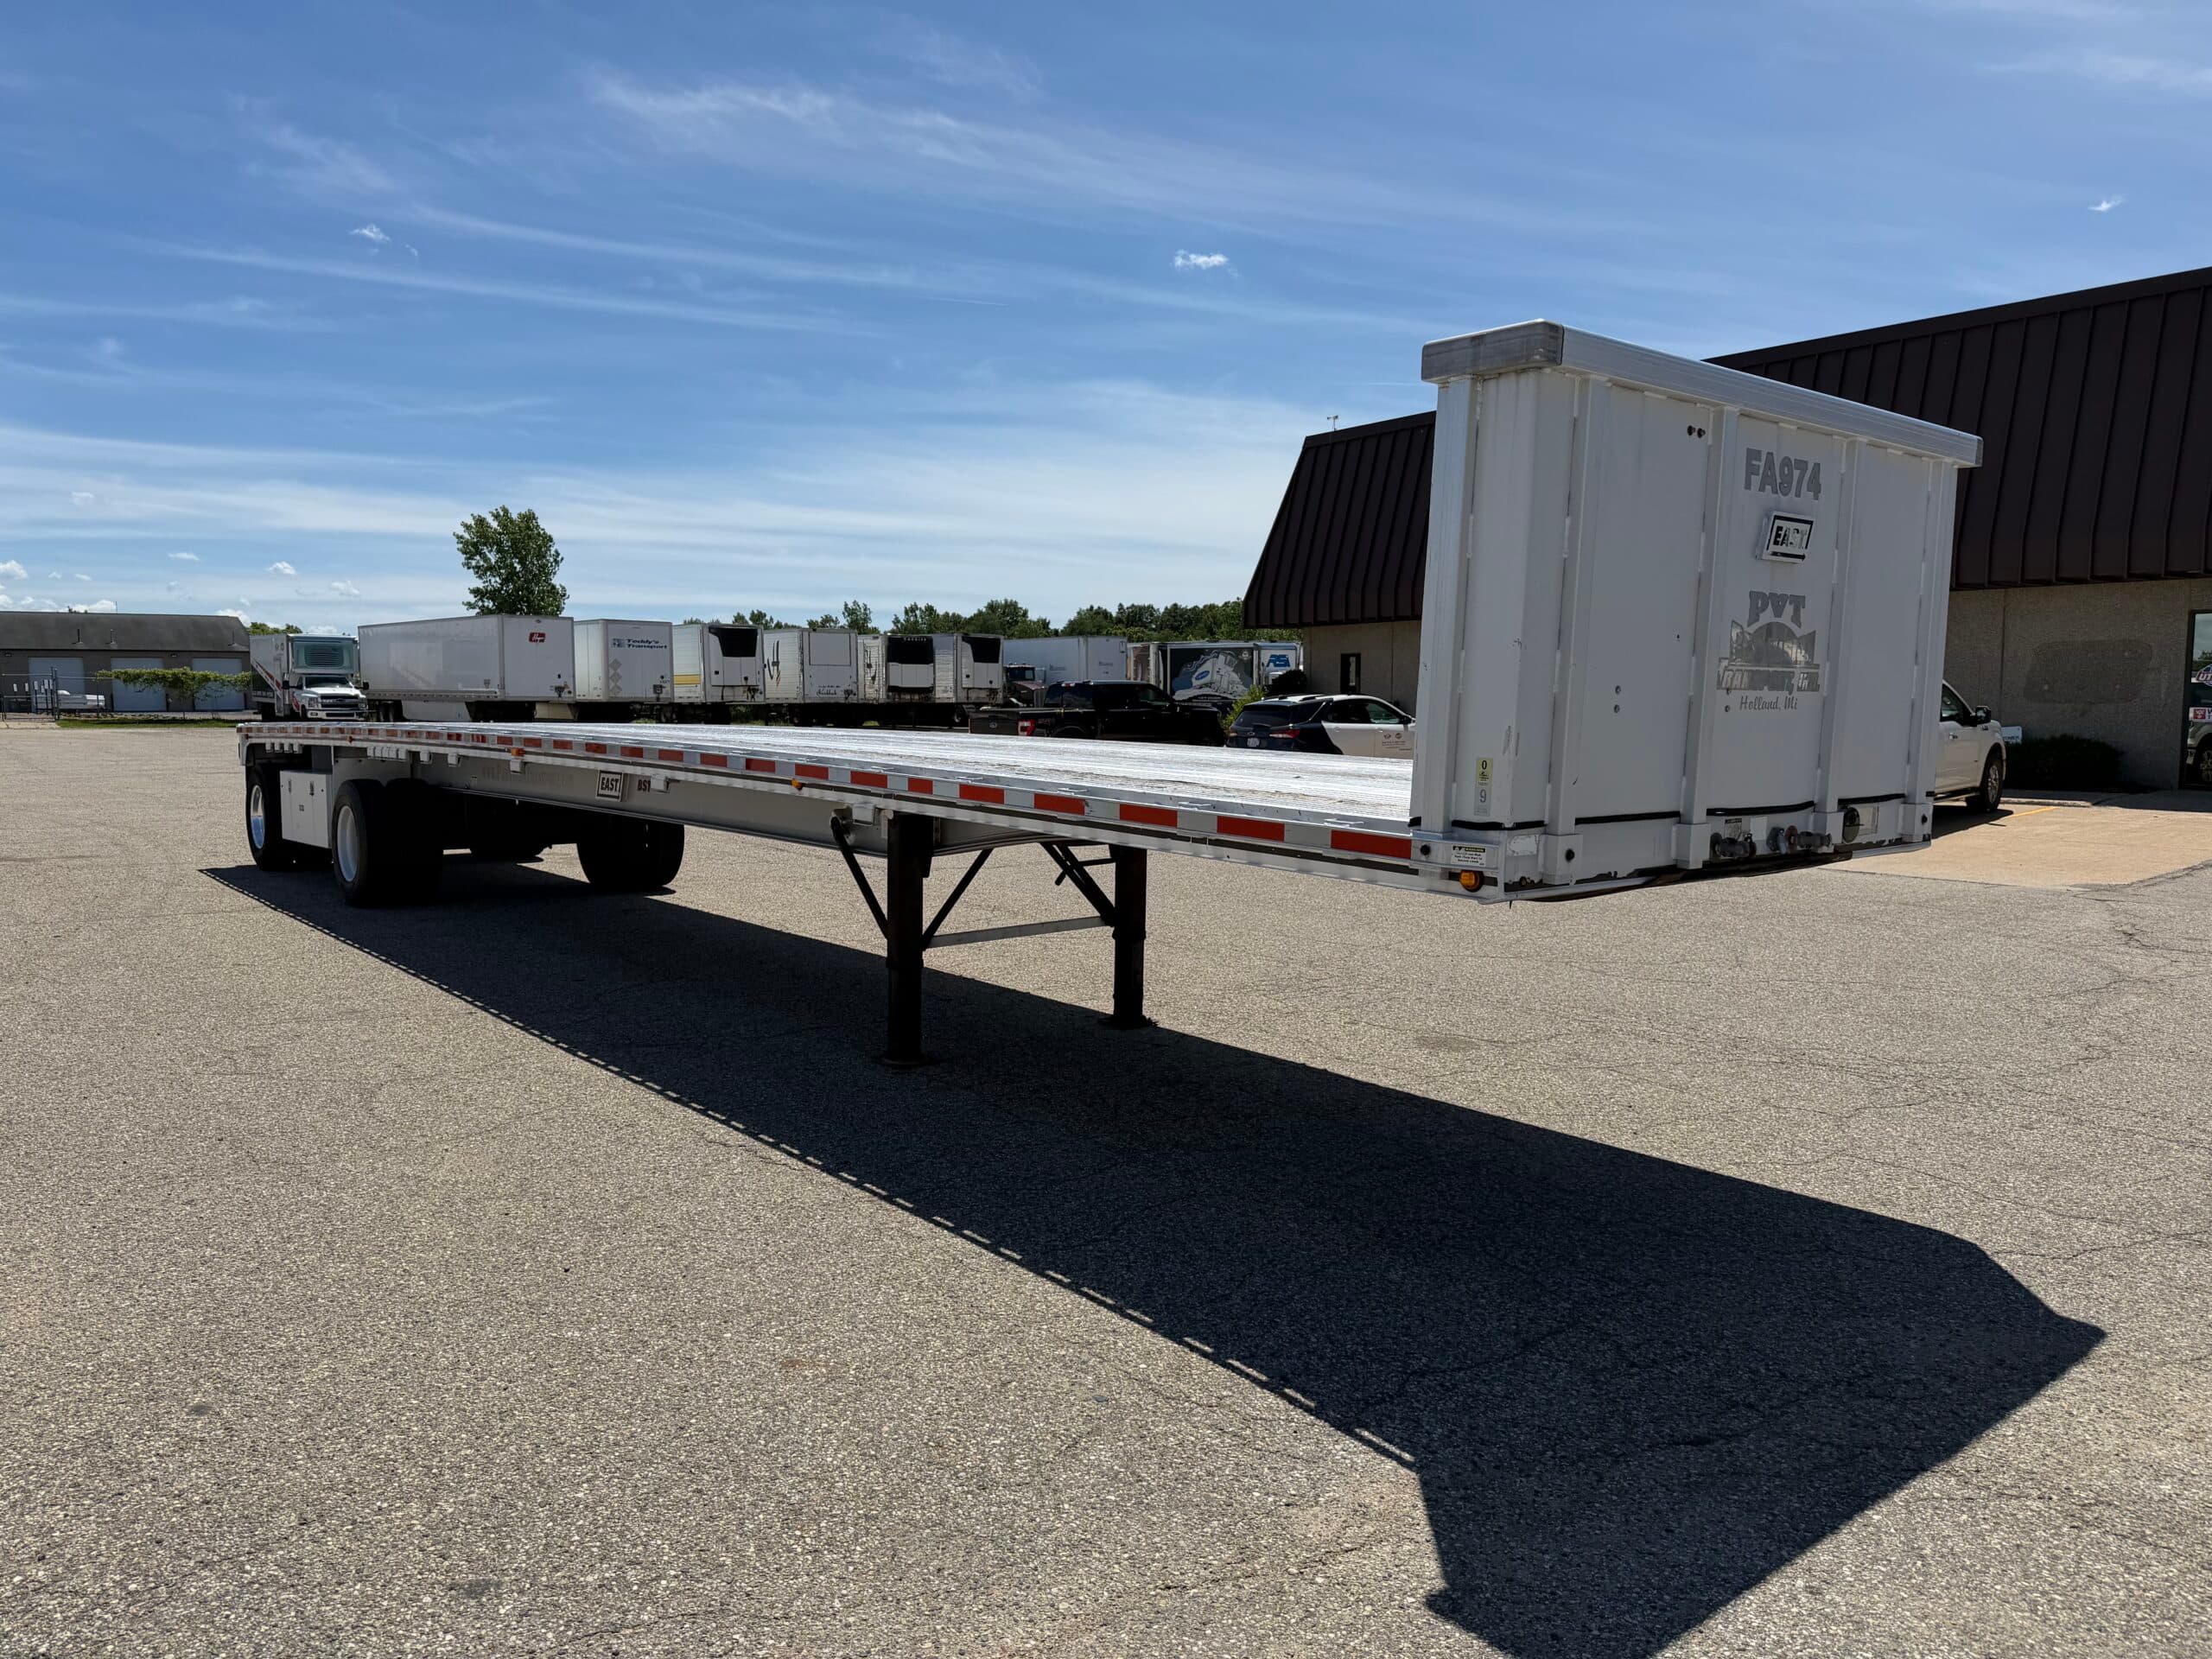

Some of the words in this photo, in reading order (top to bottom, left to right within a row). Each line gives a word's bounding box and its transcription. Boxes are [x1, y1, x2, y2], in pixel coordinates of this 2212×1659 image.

[1744, 447, 1822, 500] FA974
[1747, 590, 1806, 628] PVT
[601, 777, 620, 792] EAST
